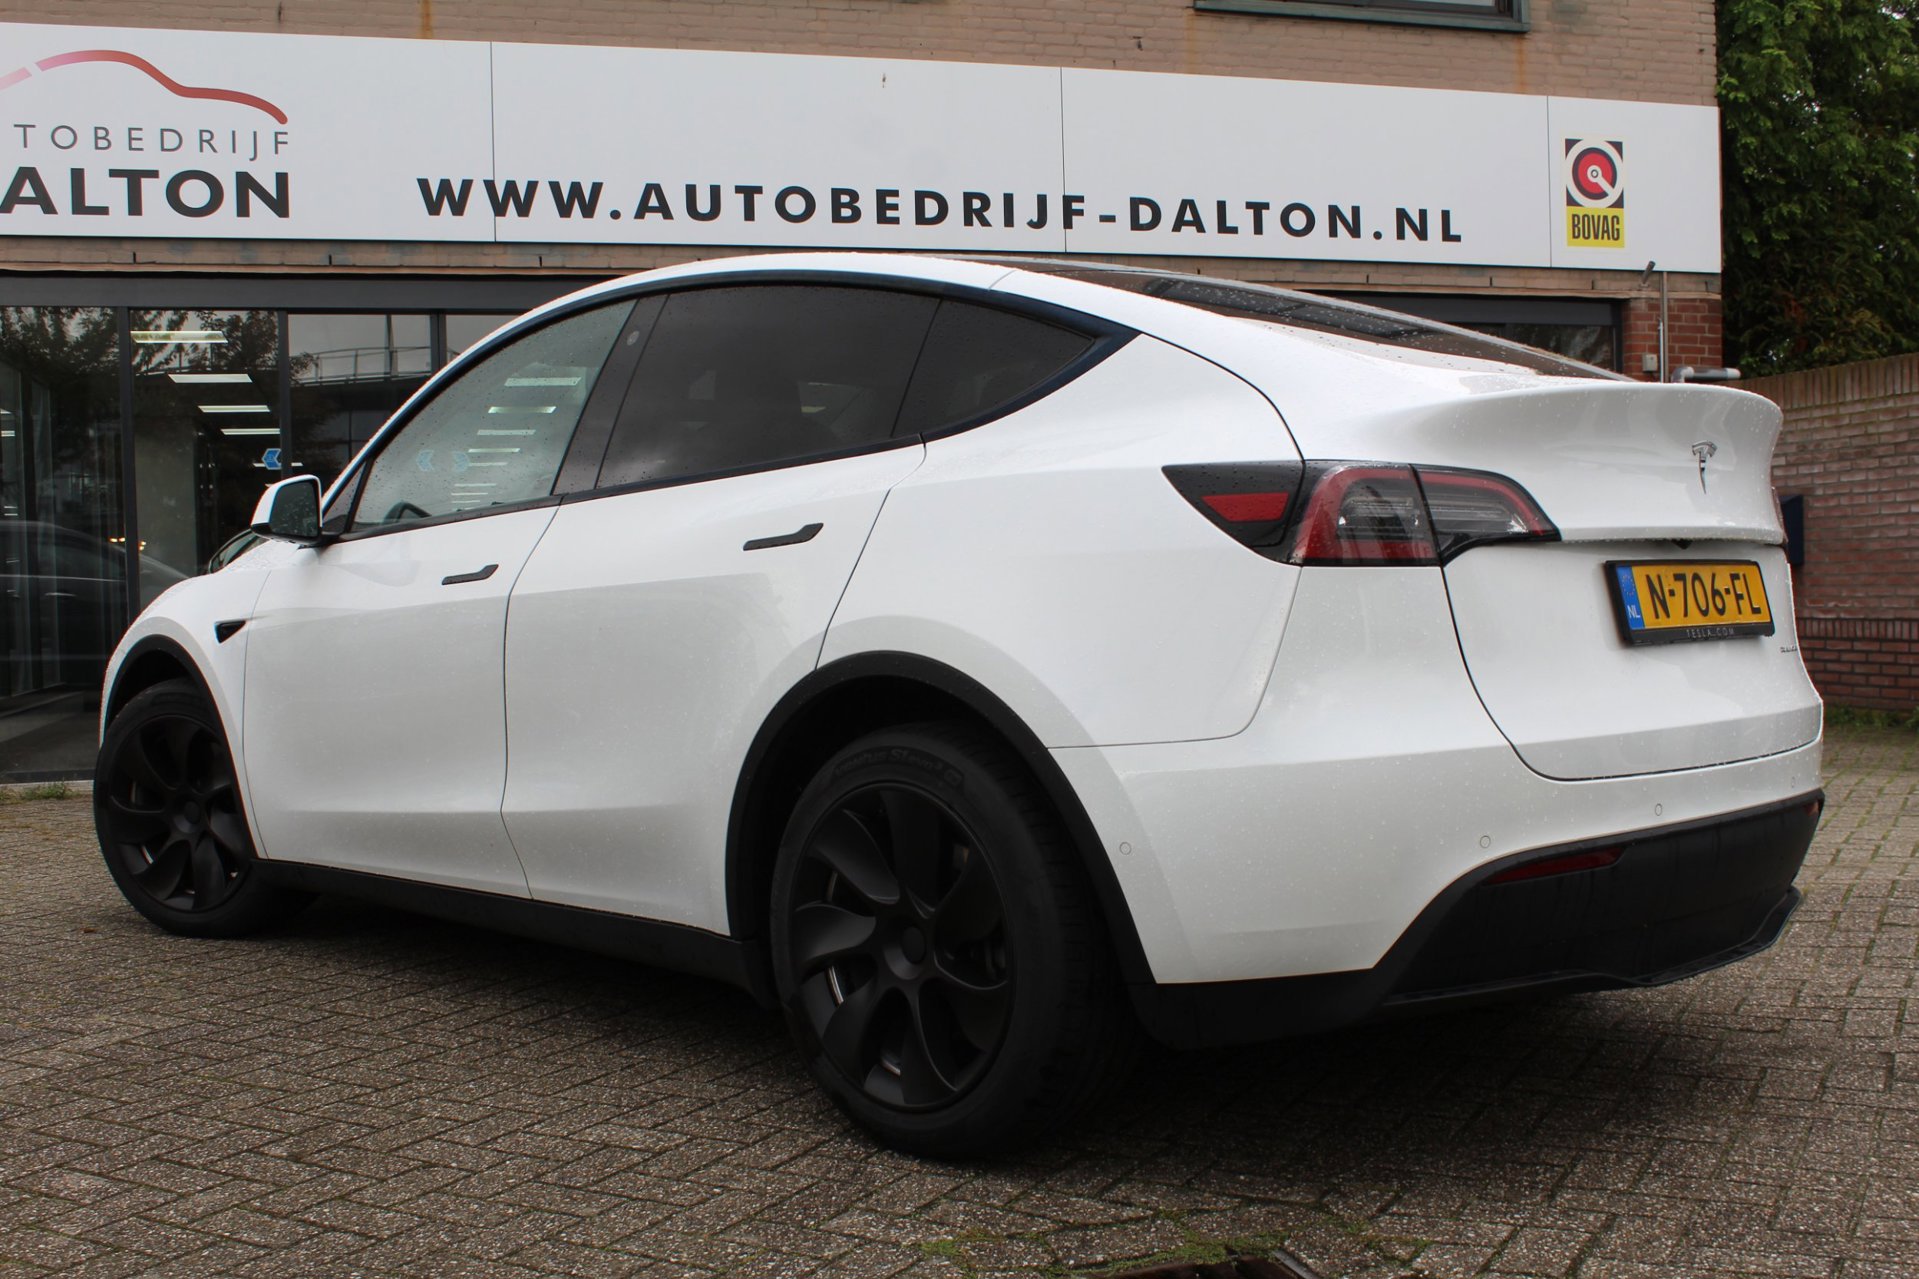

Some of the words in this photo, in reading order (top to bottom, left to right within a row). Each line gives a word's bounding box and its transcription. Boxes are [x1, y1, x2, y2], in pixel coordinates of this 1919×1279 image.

[14, 123, 289, 162] TOBEDRIJF
[0, 166, 290, 218] ALTON
[416, 177, 1462, 243] WWW.AUTOBEDRIJF-DALTON.NL
[1571, 213, 1620, 241] BOVAG
[1627, 604, 1641, 619] NL
[1645, 572, 1762, 619] N-706-FL
